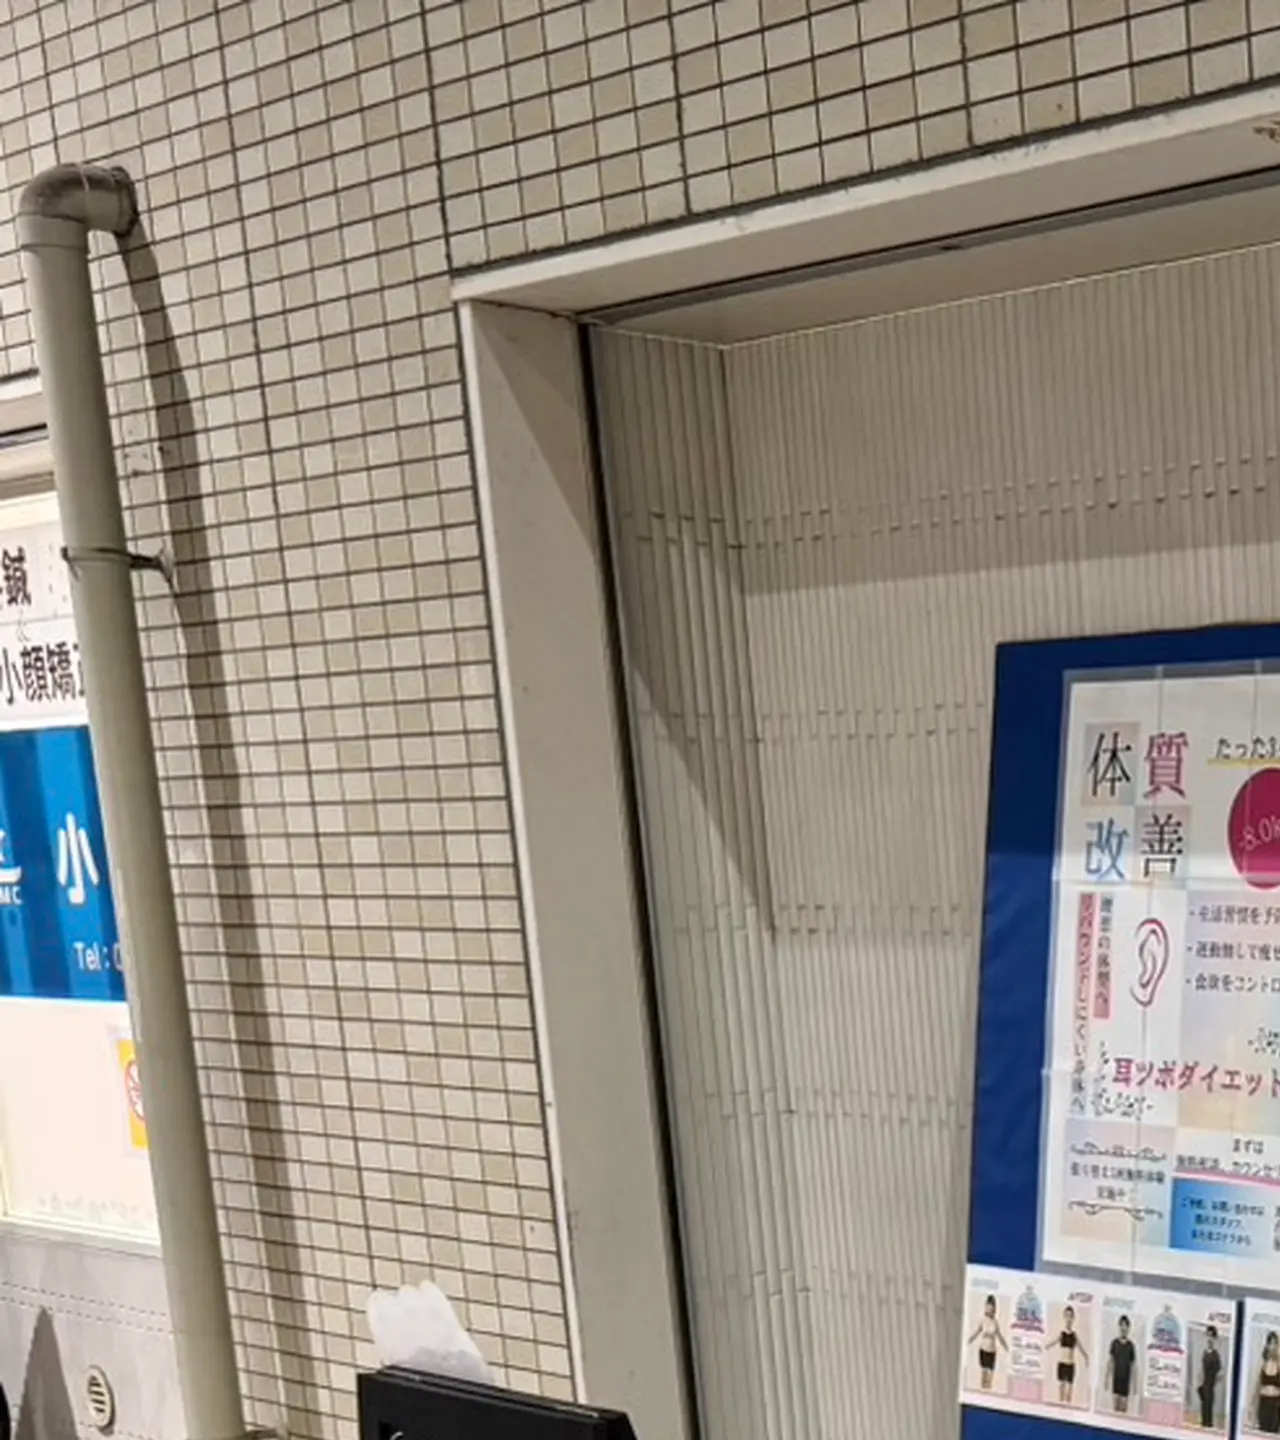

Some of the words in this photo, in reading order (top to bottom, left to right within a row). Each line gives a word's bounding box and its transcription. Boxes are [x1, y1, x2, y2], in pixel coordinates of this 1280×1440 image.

[0, 641, 86, 706] 小顔矯
[1085, 730, 1190, 801] 体質
[1084, 813, 1185, 881] 改善
